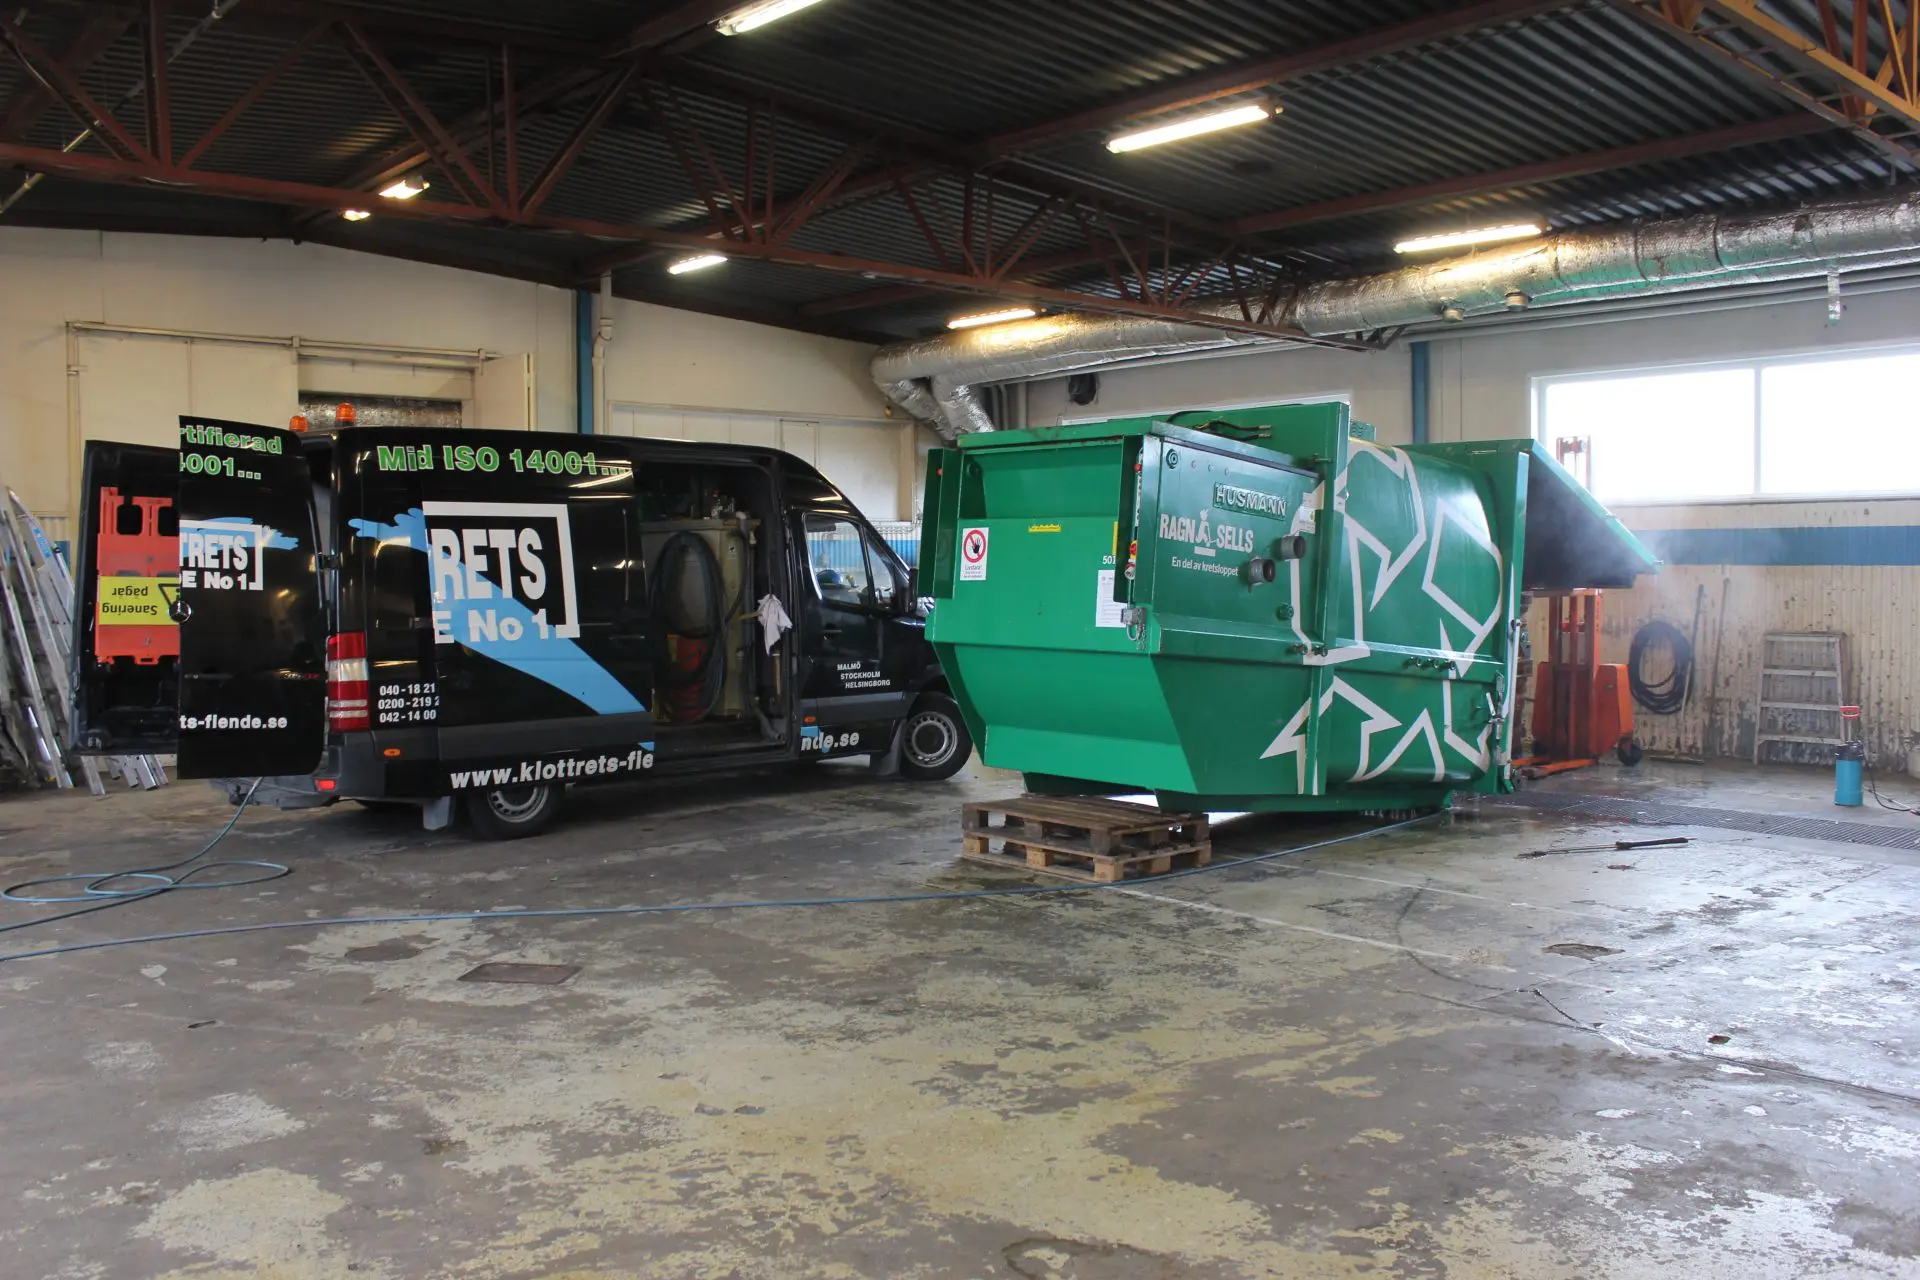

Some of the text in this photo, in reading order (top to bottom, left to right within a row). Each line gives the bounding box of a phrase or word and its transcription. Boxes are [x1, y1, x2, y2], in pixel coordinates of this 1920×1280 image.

[377, 444, 434, 472] Mid
[443, 446, 500, 472] ISO
[1216, 485, 1287, 516] HUSMANN
[1160, 514, 1254, 553] RAGN SELLS
[425, 528, 546, 600] RETS
[1171, 556, 1239, 577] En del av kretsloppet
[204, 571, 234, 590] No
[237, 573, 247, 591] 1
[102, 602, 158, 616] Sanering
[468, 608, 524, 642] No
[531, 608, 549, 640] 1
[837, 661, 861, 670] MALMÖ
[840, 671, 881, 680] STOCKHOLM
[423, 683, 436, 694] 21
[845, 680, 891, 689] HELSINGBORG
[378, 698, 405, 710] 0200
[412, 696, 432, 708] 219
[423, 709, 437, 720] 00
[801, 731, 860, 751] nde.se
